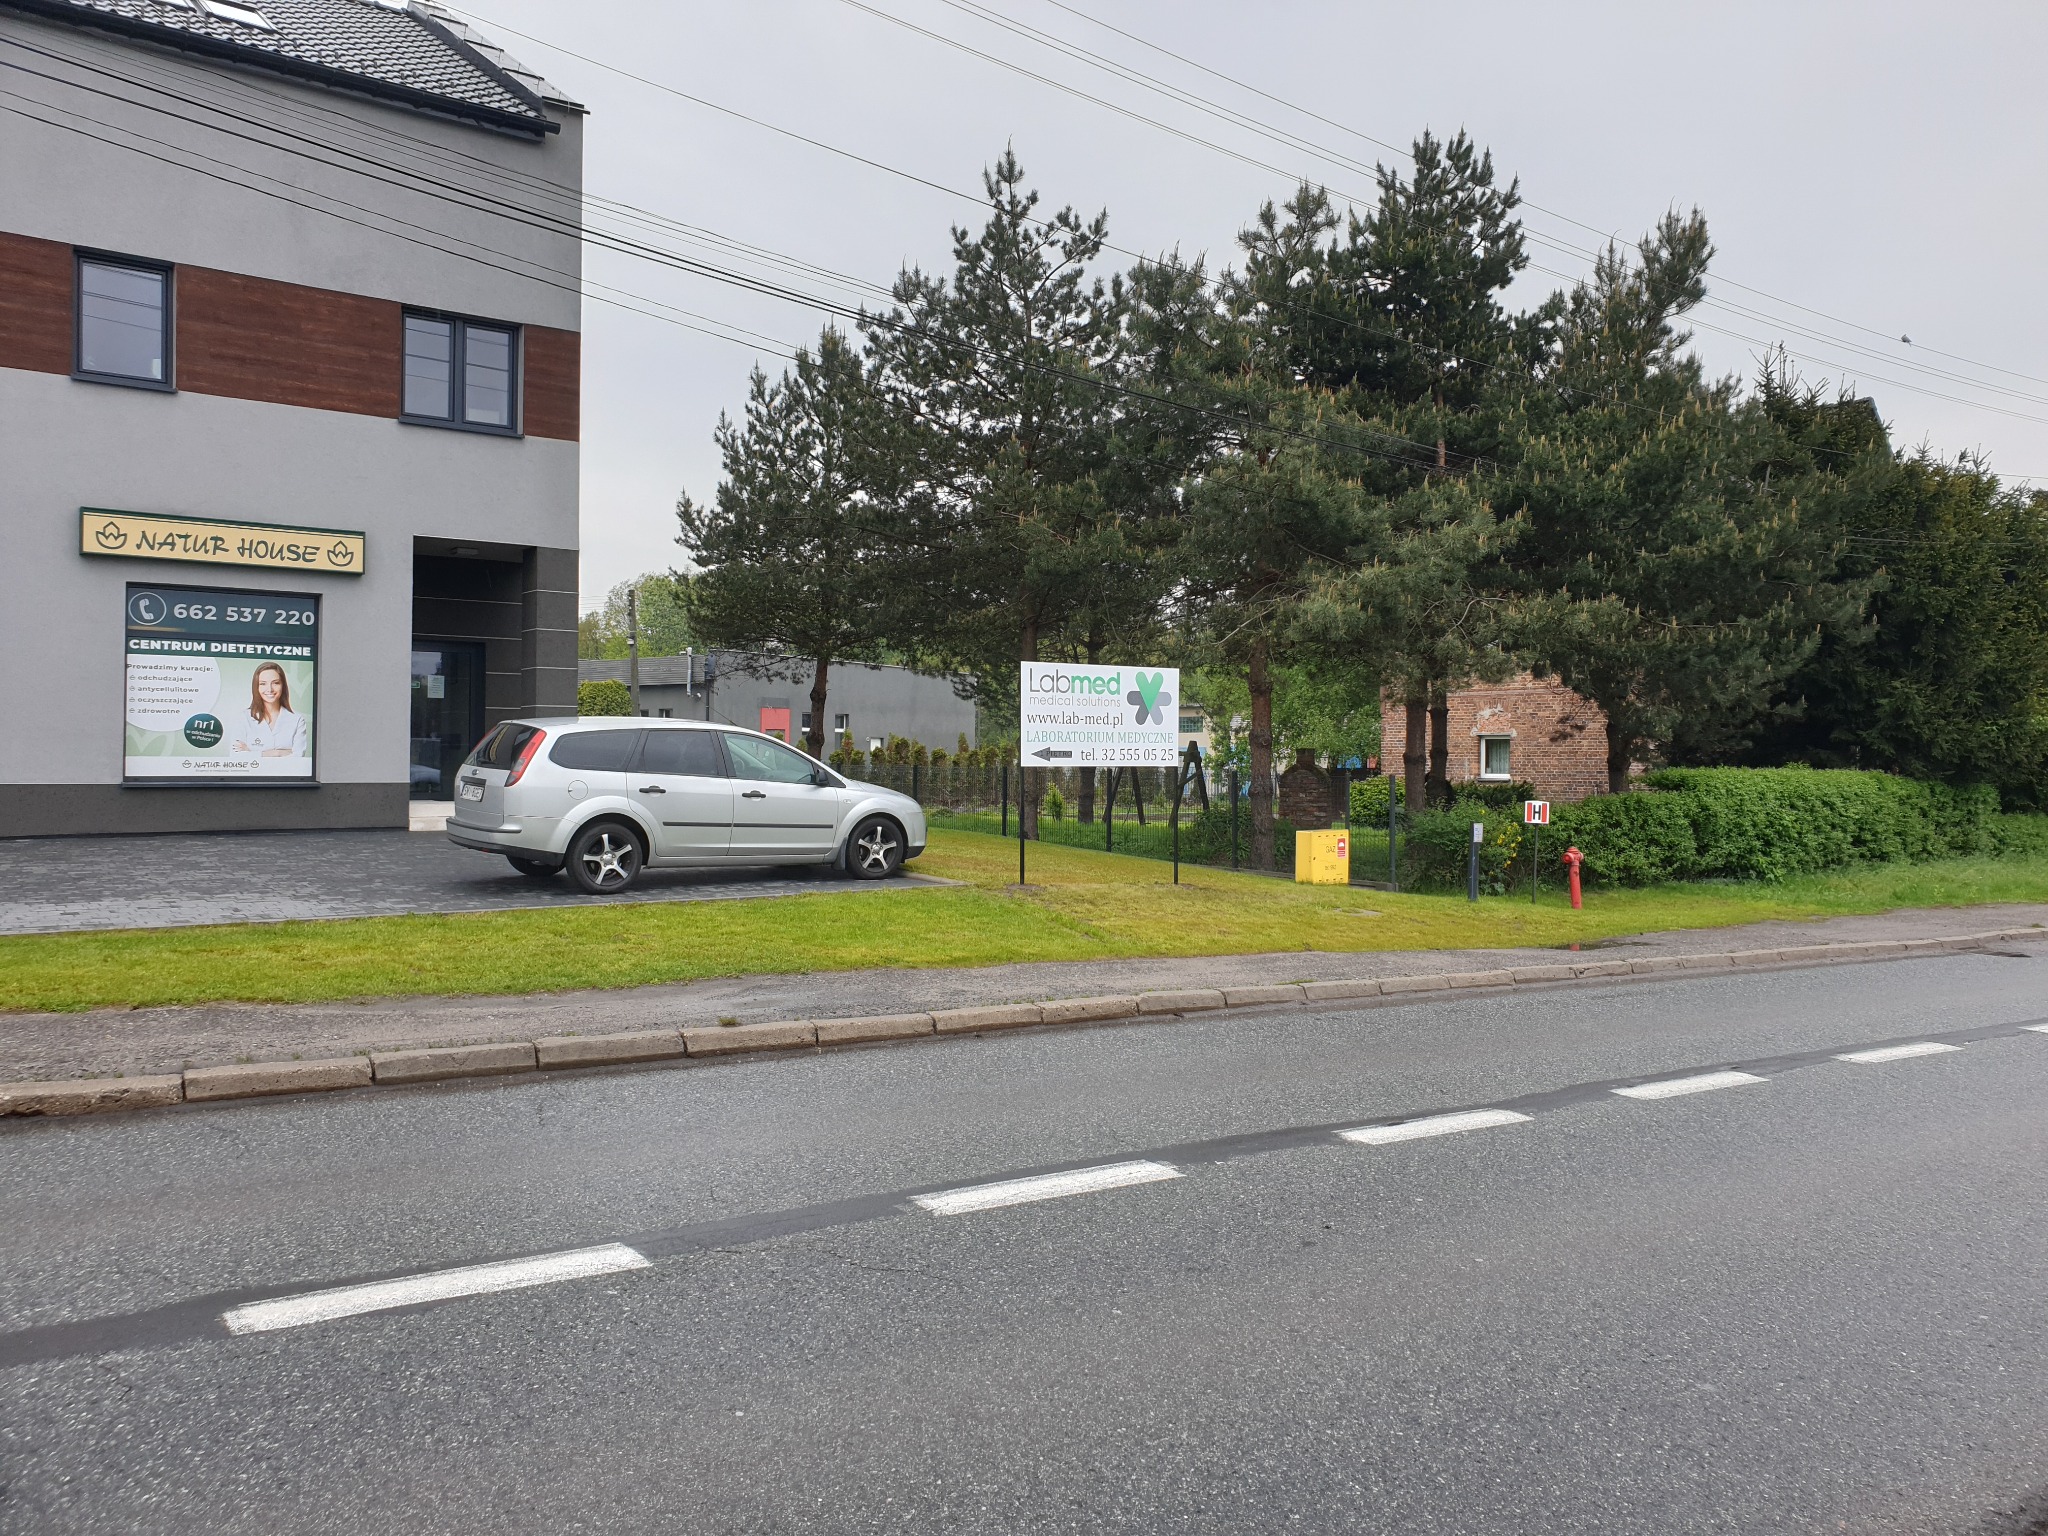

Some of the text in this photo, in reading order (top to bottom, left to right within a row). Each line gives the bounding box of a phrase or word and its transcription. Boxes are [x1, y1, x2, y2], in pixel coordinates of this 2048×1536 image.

[136, 531, 320, 562] NATUR HOUSE
[173, 604, 315, 626] 662 537 220
[129, 639, 312, 656] CENTRUM DIETETYCZNE
[127, 663, 178, 671] Prowadzimy
[1029, 668, 1121, 695] Labmed
[1029, 695, 1121, 708] medical solutions
[1027, 711, 1123, 728] www.lab-med.pl
[1026, 730, 1174, 744] LABORATORIUM MEDYCZNE
[1081, 748, 1174, 761] tel. 32 555 05 25
[1533, 804, 1542, 820] H
